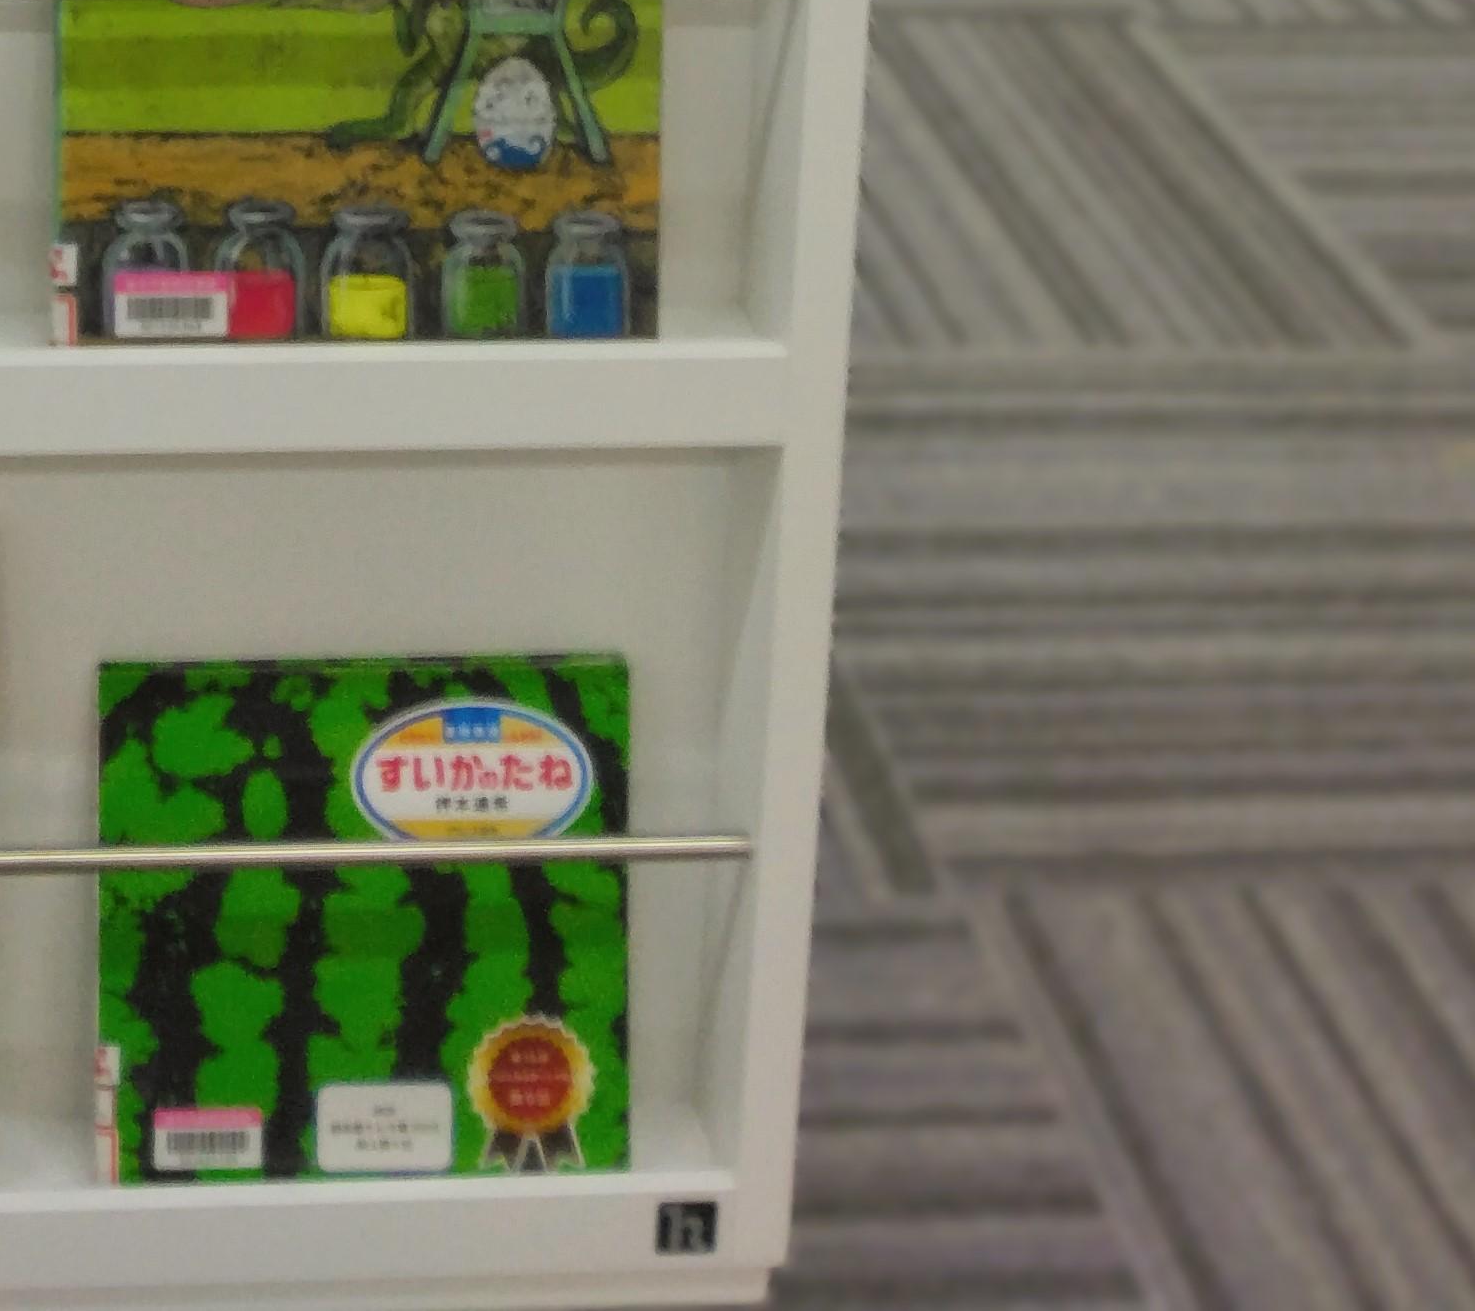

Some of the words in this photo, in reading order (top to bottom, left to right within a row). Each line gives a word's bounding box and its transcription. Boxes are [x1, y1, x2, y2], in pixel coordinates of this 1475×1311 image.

[376, 753, 573, 794] すいかのたね
